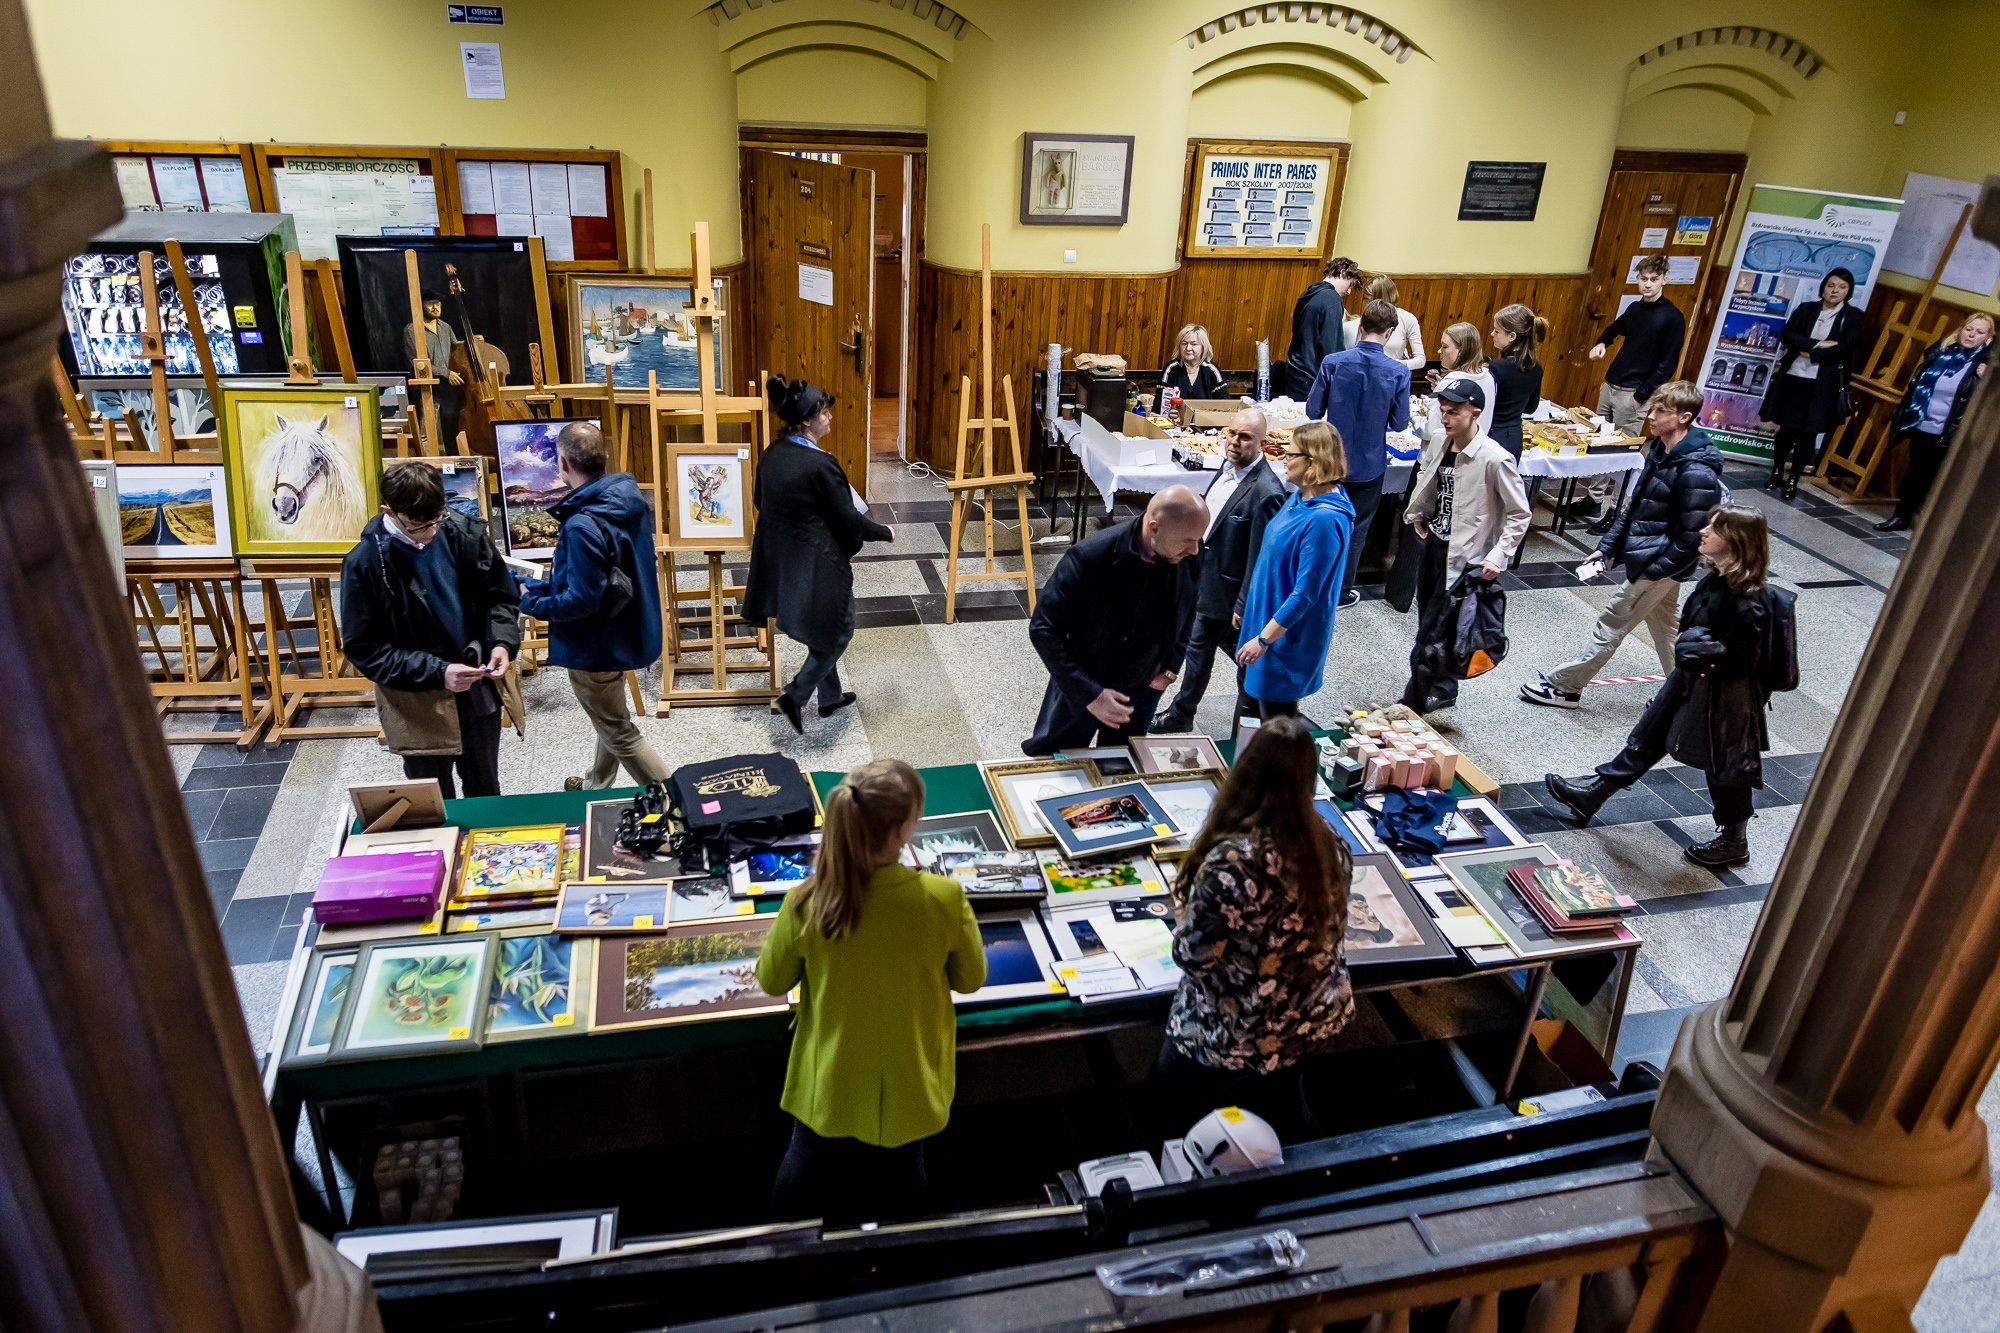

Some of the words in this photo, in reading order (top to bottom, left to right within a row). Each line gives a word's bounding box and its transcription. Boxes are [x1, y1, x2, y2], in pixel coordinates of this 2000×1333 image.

[471, 8, 498, 16] OBIEKT
[288, 160, 415, 174] PRZEDSIĘBIORCZOŚĆ
[1211, 161, 1249, 178] PRIMUS
[1254, 162, 1283, 179] INTER
[1287, 163, 1317, 180] PARES
[800, 185, 812, 194] 204
[1225, 180, 1241, 188] ROK
[1241, 180, 1273, 188] SZKOLNY
[1277, 180, 1313, 190] 2007/2008
[1752, 222, 1782, 231] Uzdrowisko
[1782, 225, 1803, 234] Cieplice
[1707, 433, 1775, 451] w.uzdrowisko-ci
[96, 478, 105, 486] 12
